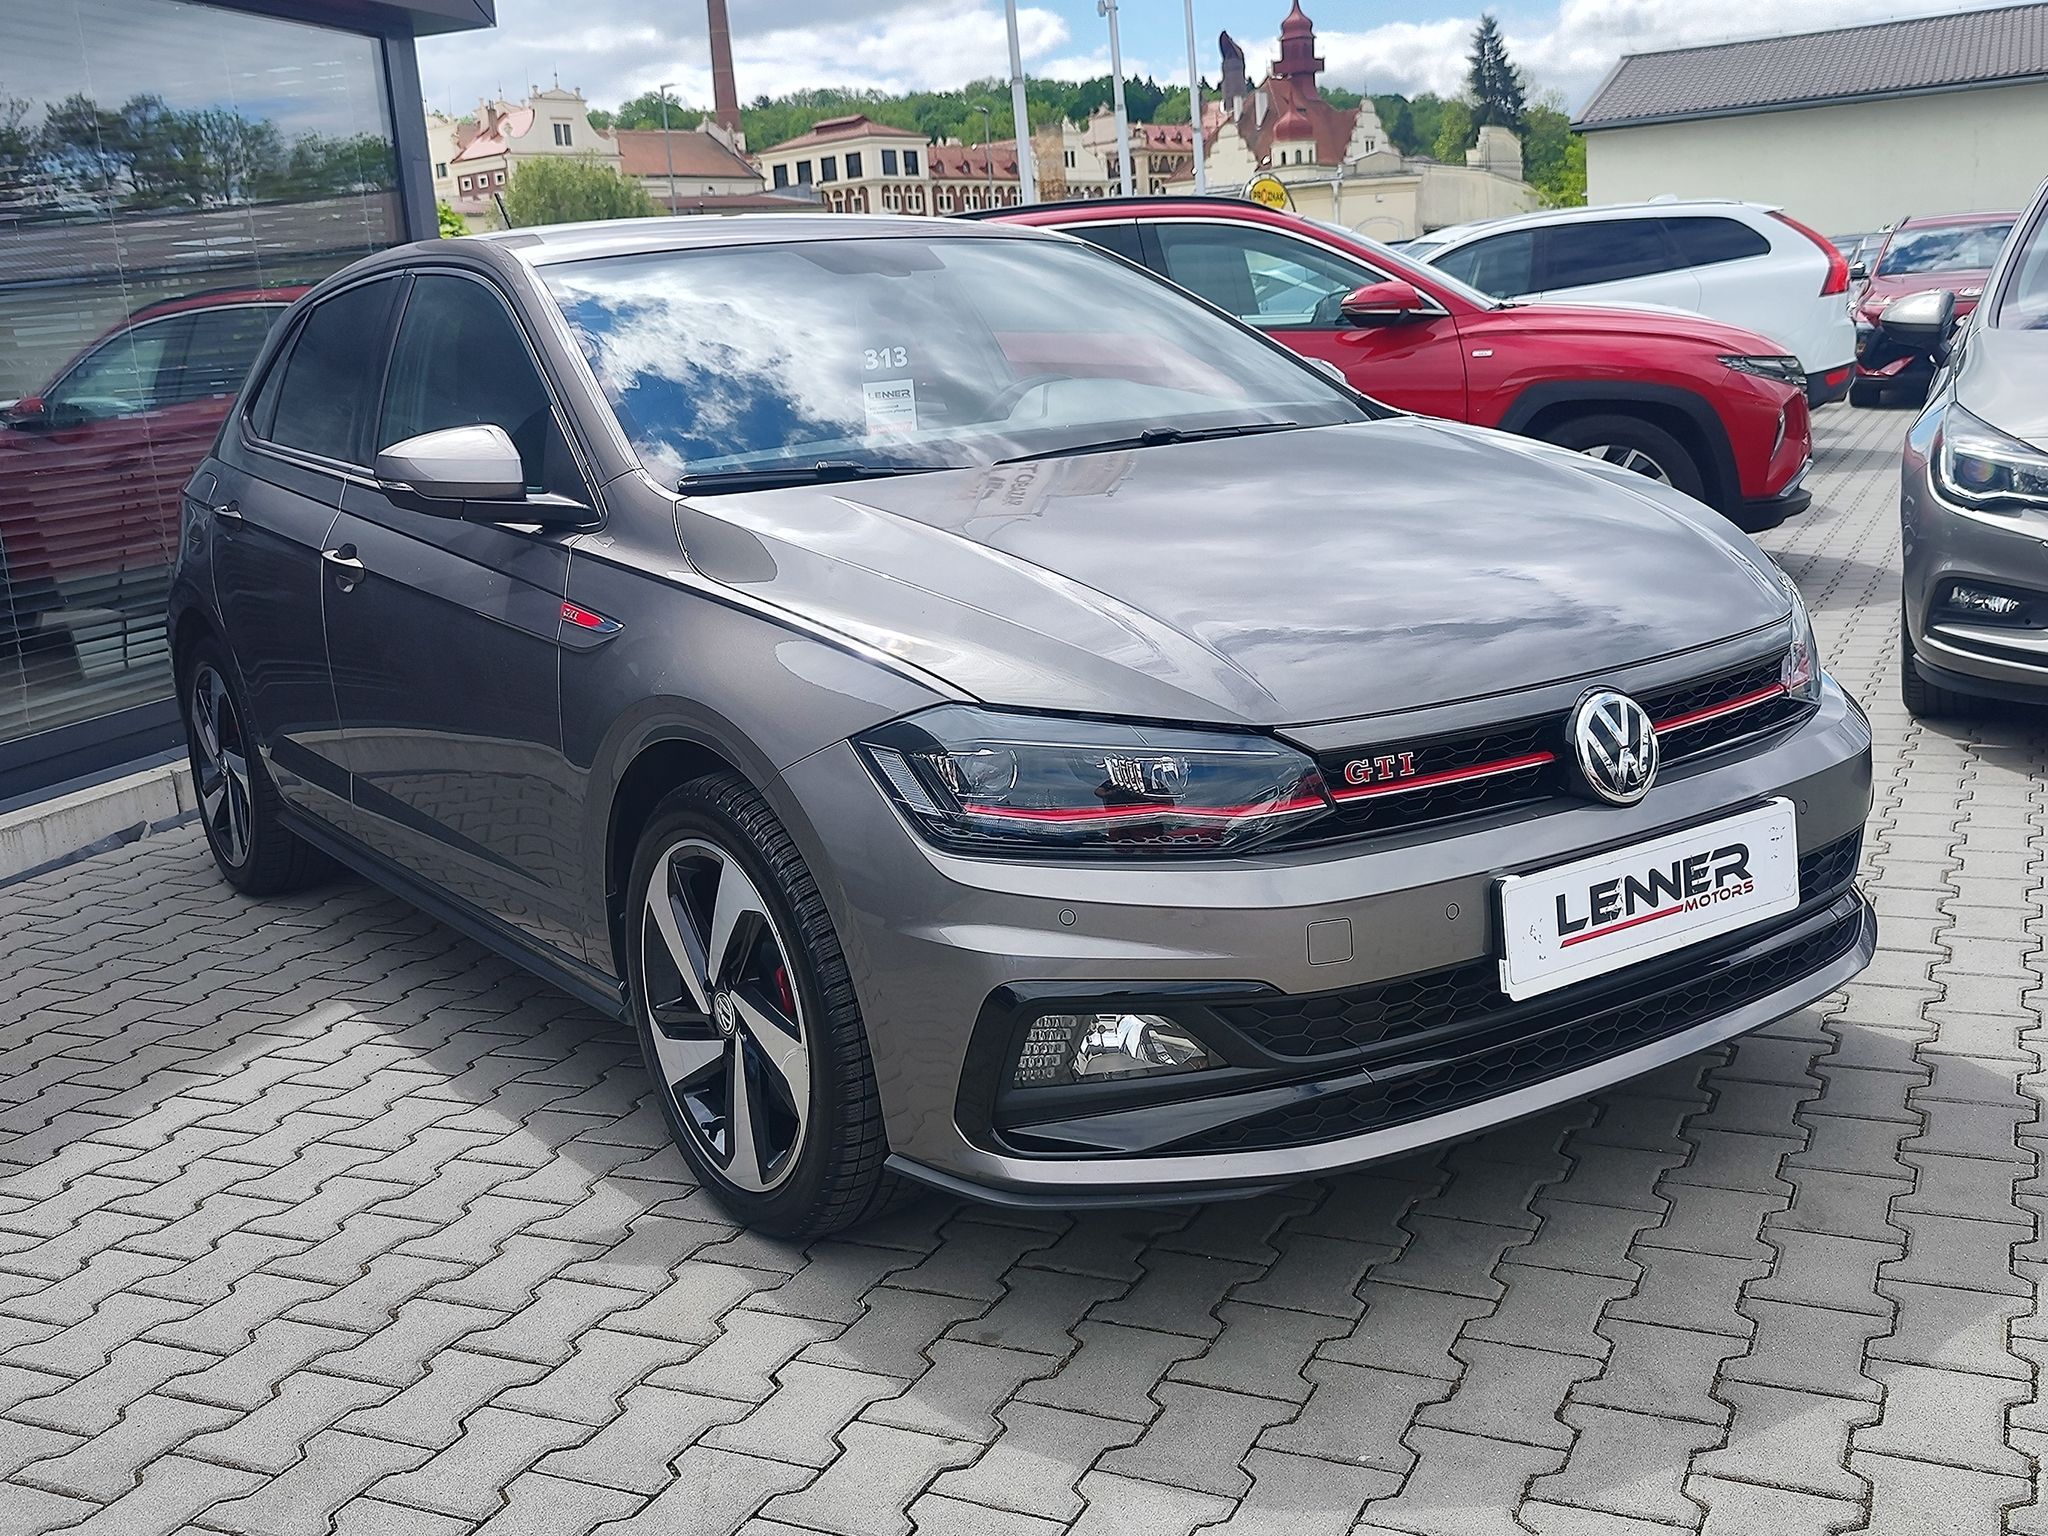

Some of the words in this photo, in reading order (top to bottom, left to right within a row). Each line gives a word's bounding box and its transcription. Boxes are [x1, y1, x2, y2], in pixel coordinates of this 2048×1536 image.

[864, 346, 908, 370] 313
[868, 389, 911, 399] LENNER
[1345, 751, 1416, 785] GTI
[1555, 842, 1753, 937] LENNER
[1682, 880, 1755, 914] MOTORS
